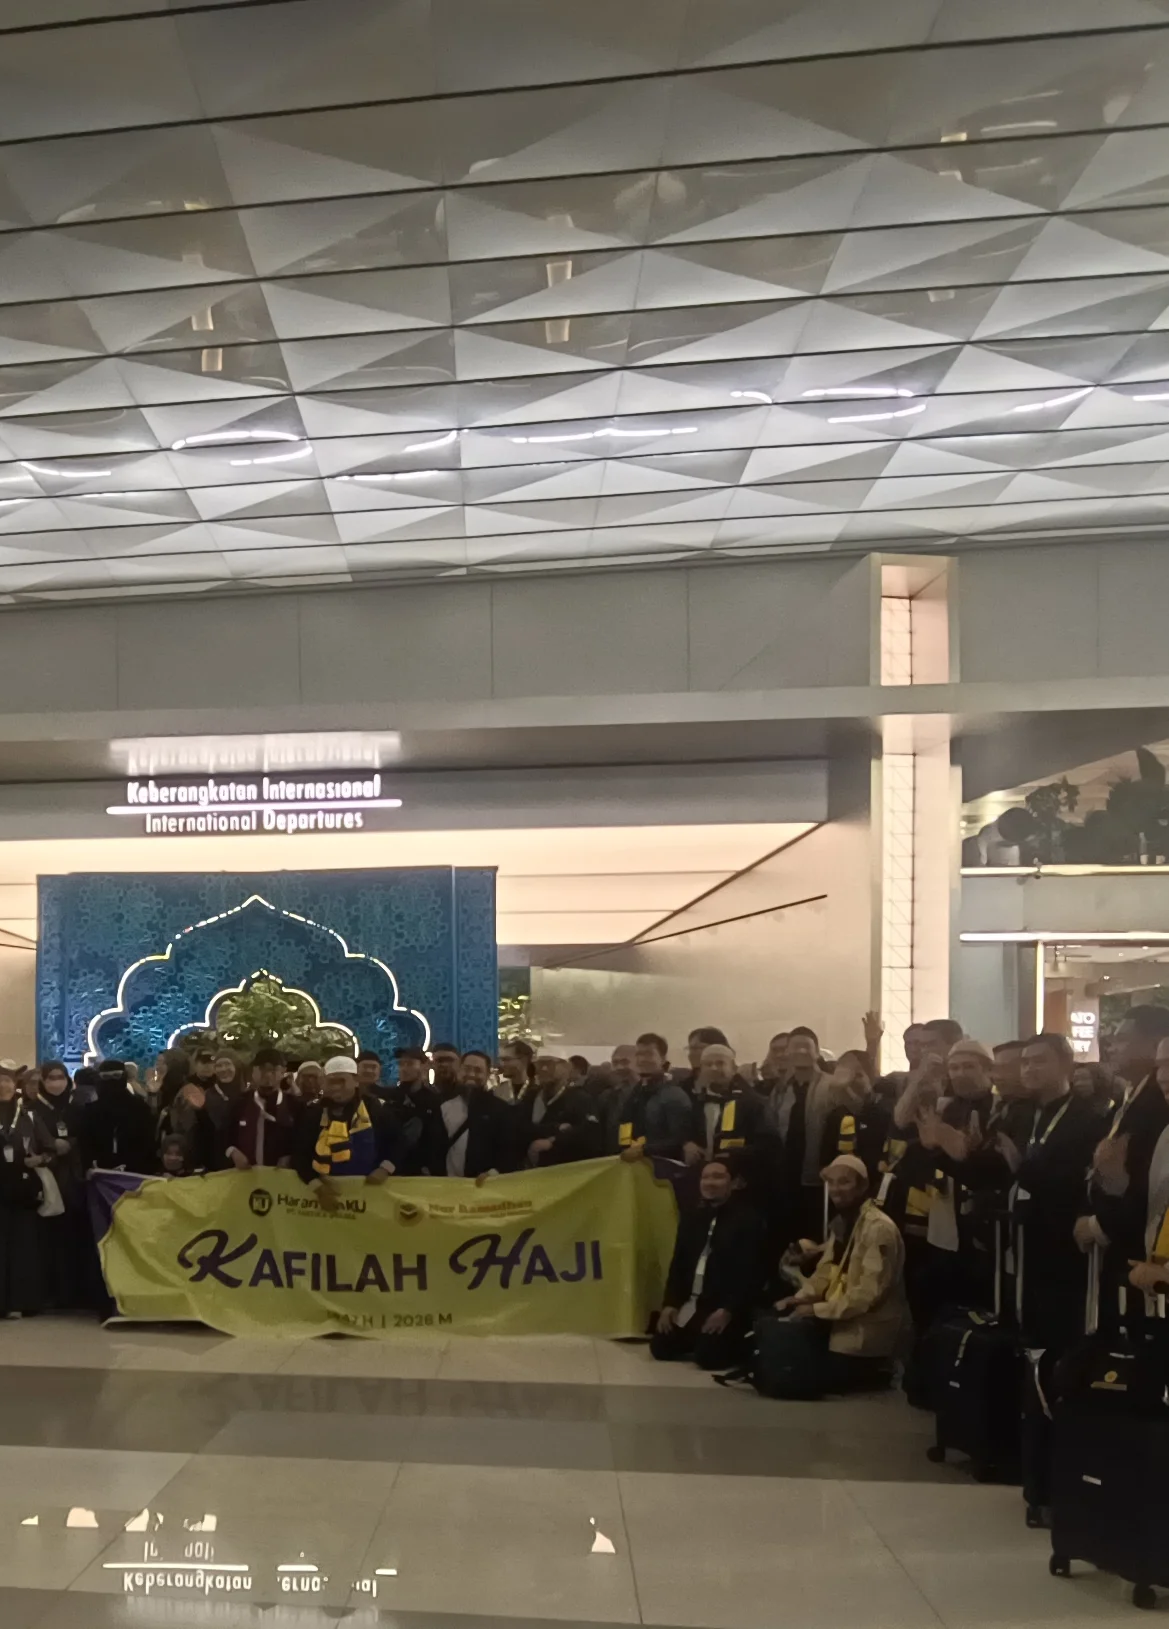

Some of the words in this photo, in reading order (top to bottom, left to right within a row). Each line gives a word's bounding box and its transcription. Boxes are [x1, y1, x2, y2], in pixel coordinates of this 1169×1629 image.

[127, 779, 258, 805] Keberangkatan
[262, 773, 382, 801] Internasional
[145, 811, 257, 833] International
[262, 809, 364, 834] Departures
[176, 1228, 429, 1293] KAFILAH
[448, 1227, 604, 1290] HAJI
[438, 1312, 453, 1325] M
